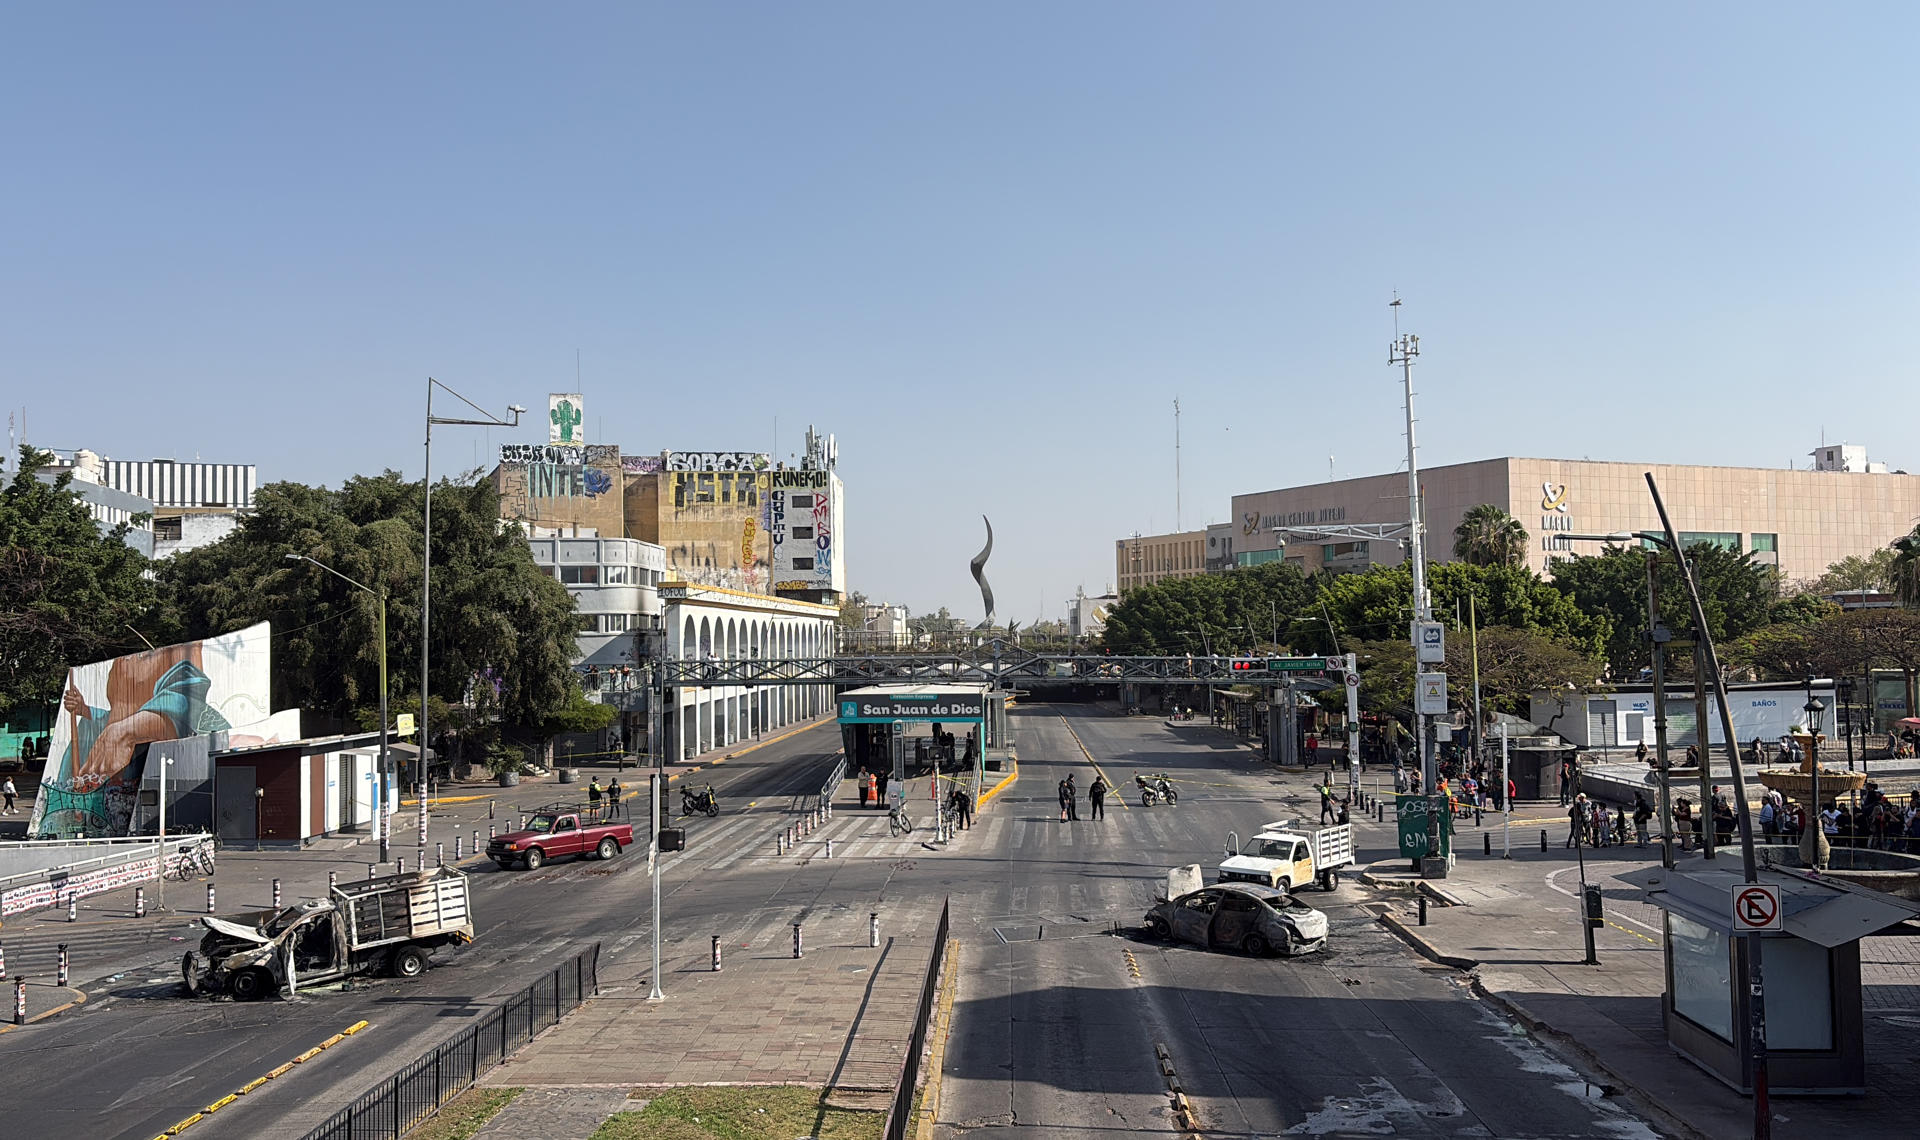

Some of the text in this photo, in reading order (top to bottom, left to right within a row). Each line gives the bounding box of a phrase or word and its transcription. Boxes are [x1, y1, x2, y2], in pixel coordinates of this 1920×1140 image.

[863, 703, 980, 715] San Juan de Dios
[1751, 700, 1776, 708] BAÑOS
